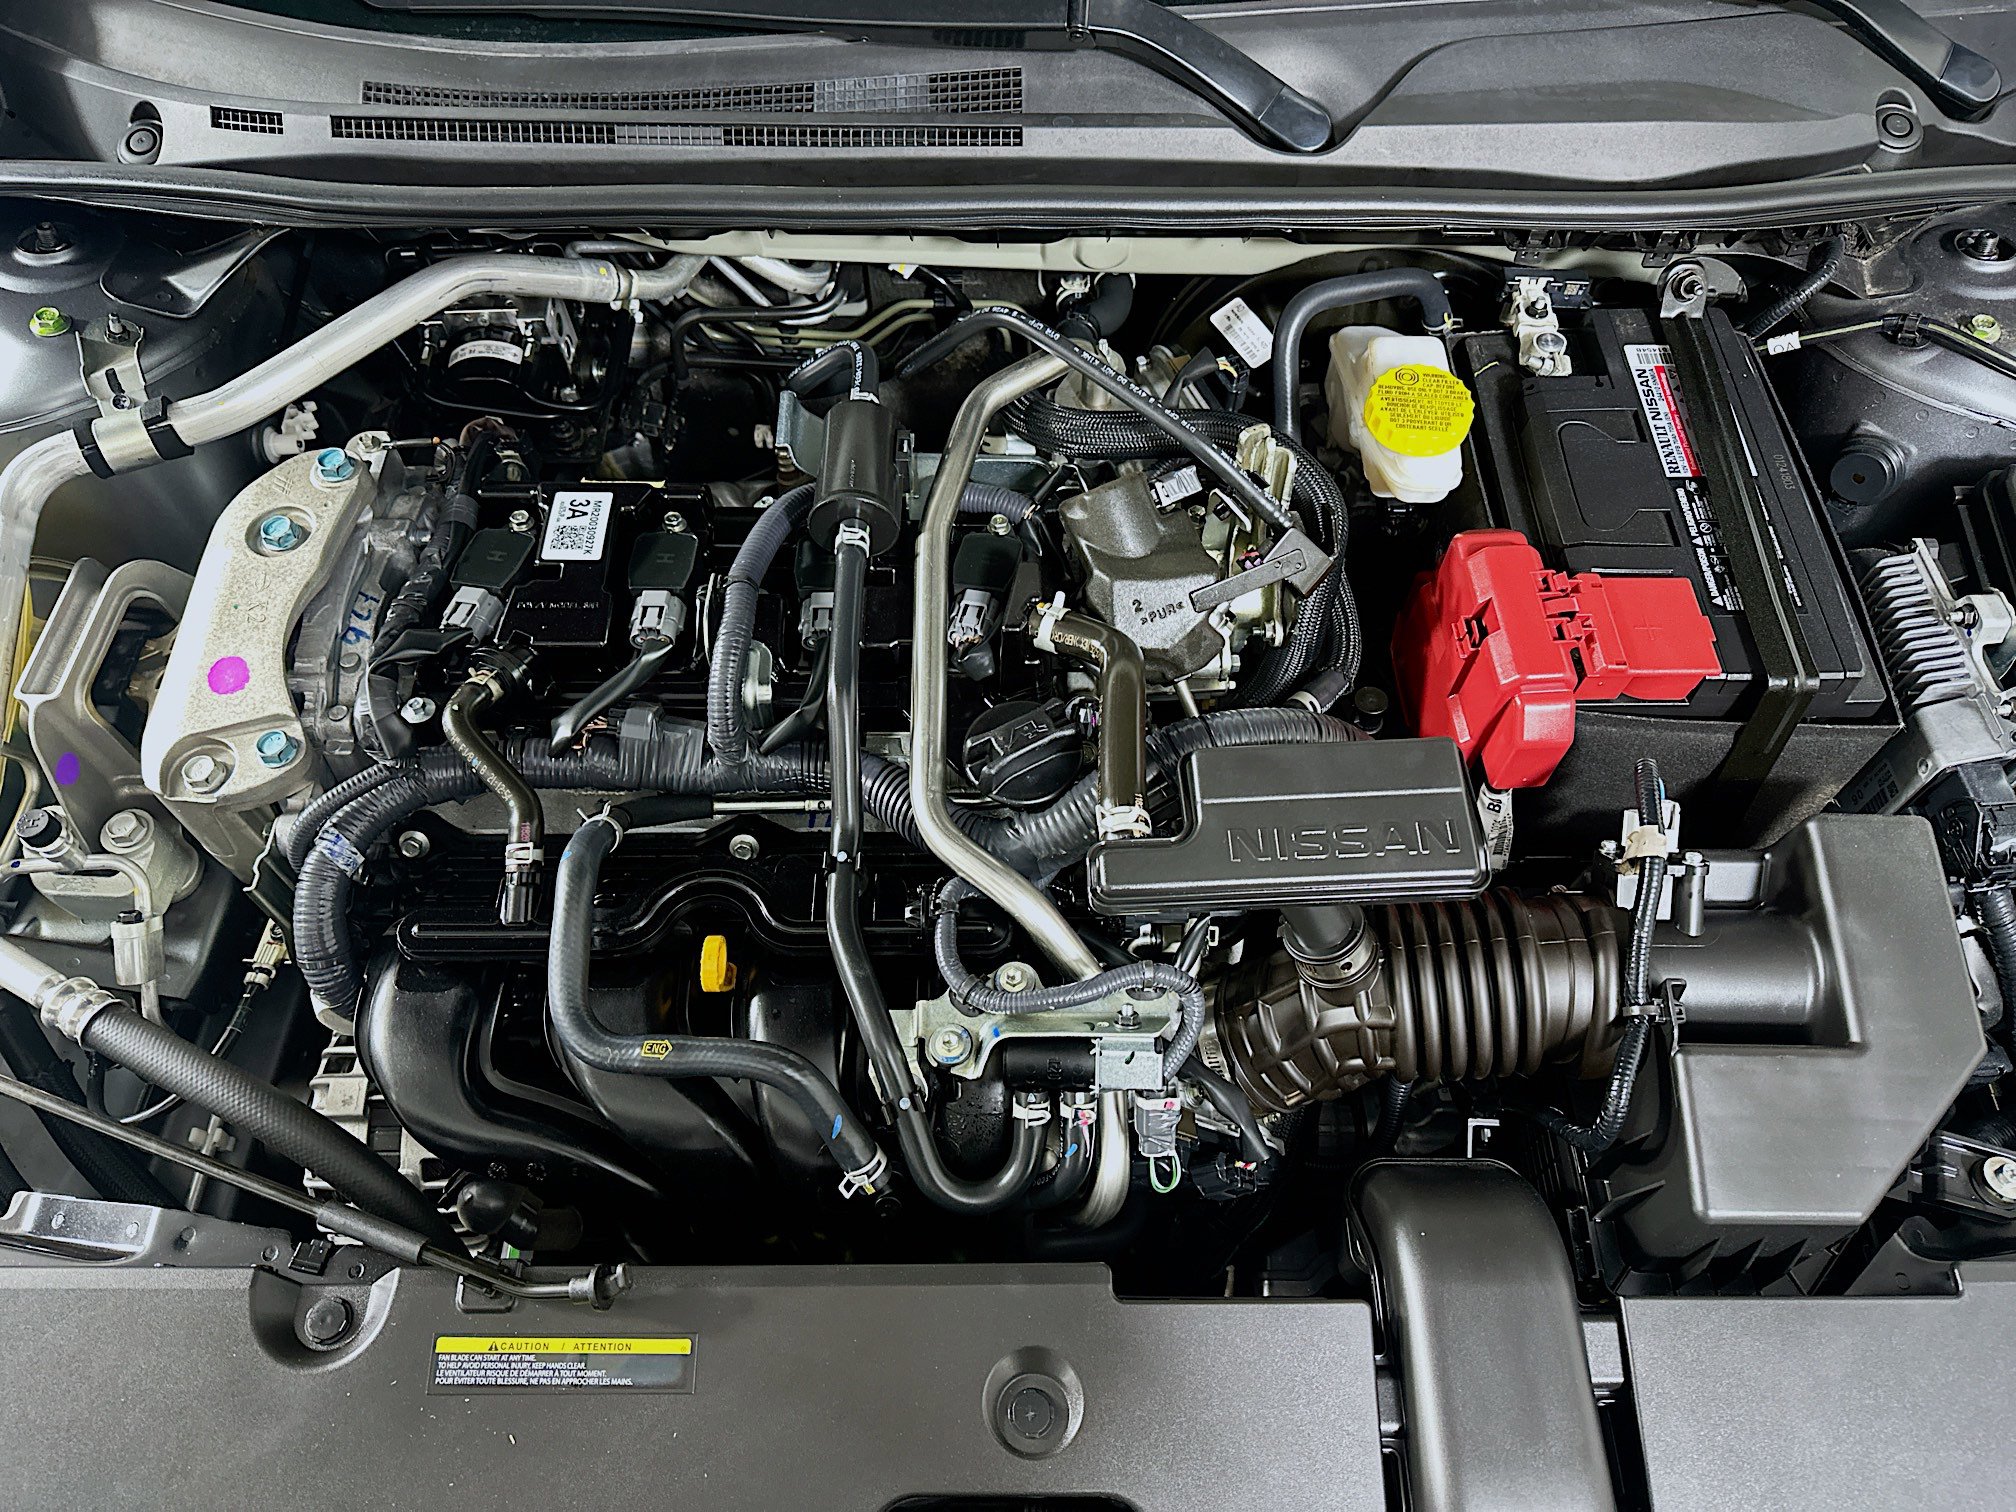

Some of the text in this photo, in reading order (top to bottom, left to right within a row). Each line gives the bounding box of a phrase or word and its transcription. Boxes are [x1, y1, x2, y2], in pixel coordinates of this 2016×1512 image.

[1635, 369, 1680, 474] RENAULT NISSAN
[567, 499, 591, 520] 3A
[1132, 599, 1143, 613] 2
[1226, 819, 1462, 863] NISSAN
[645, 1043, 667, 1054] ENG
[500, 1343, 550, 1351] CAUTION
[573, 1343, 632, 1351] ATTENTION
[469, 1354, 483, 1362] CAN
[483, 1354, 501, 1362] START
[500, 1354, 508, 1362] AT
[531, 1362, 547, 1370] KEEP
[546, 1362, 567, 1370] HANDS
[486, 1370, 509, 1378] RISQUE
[521, 1369, 554, 1377] DÉMARRER
[454, 1376, 475, 1385] ÉVITER
